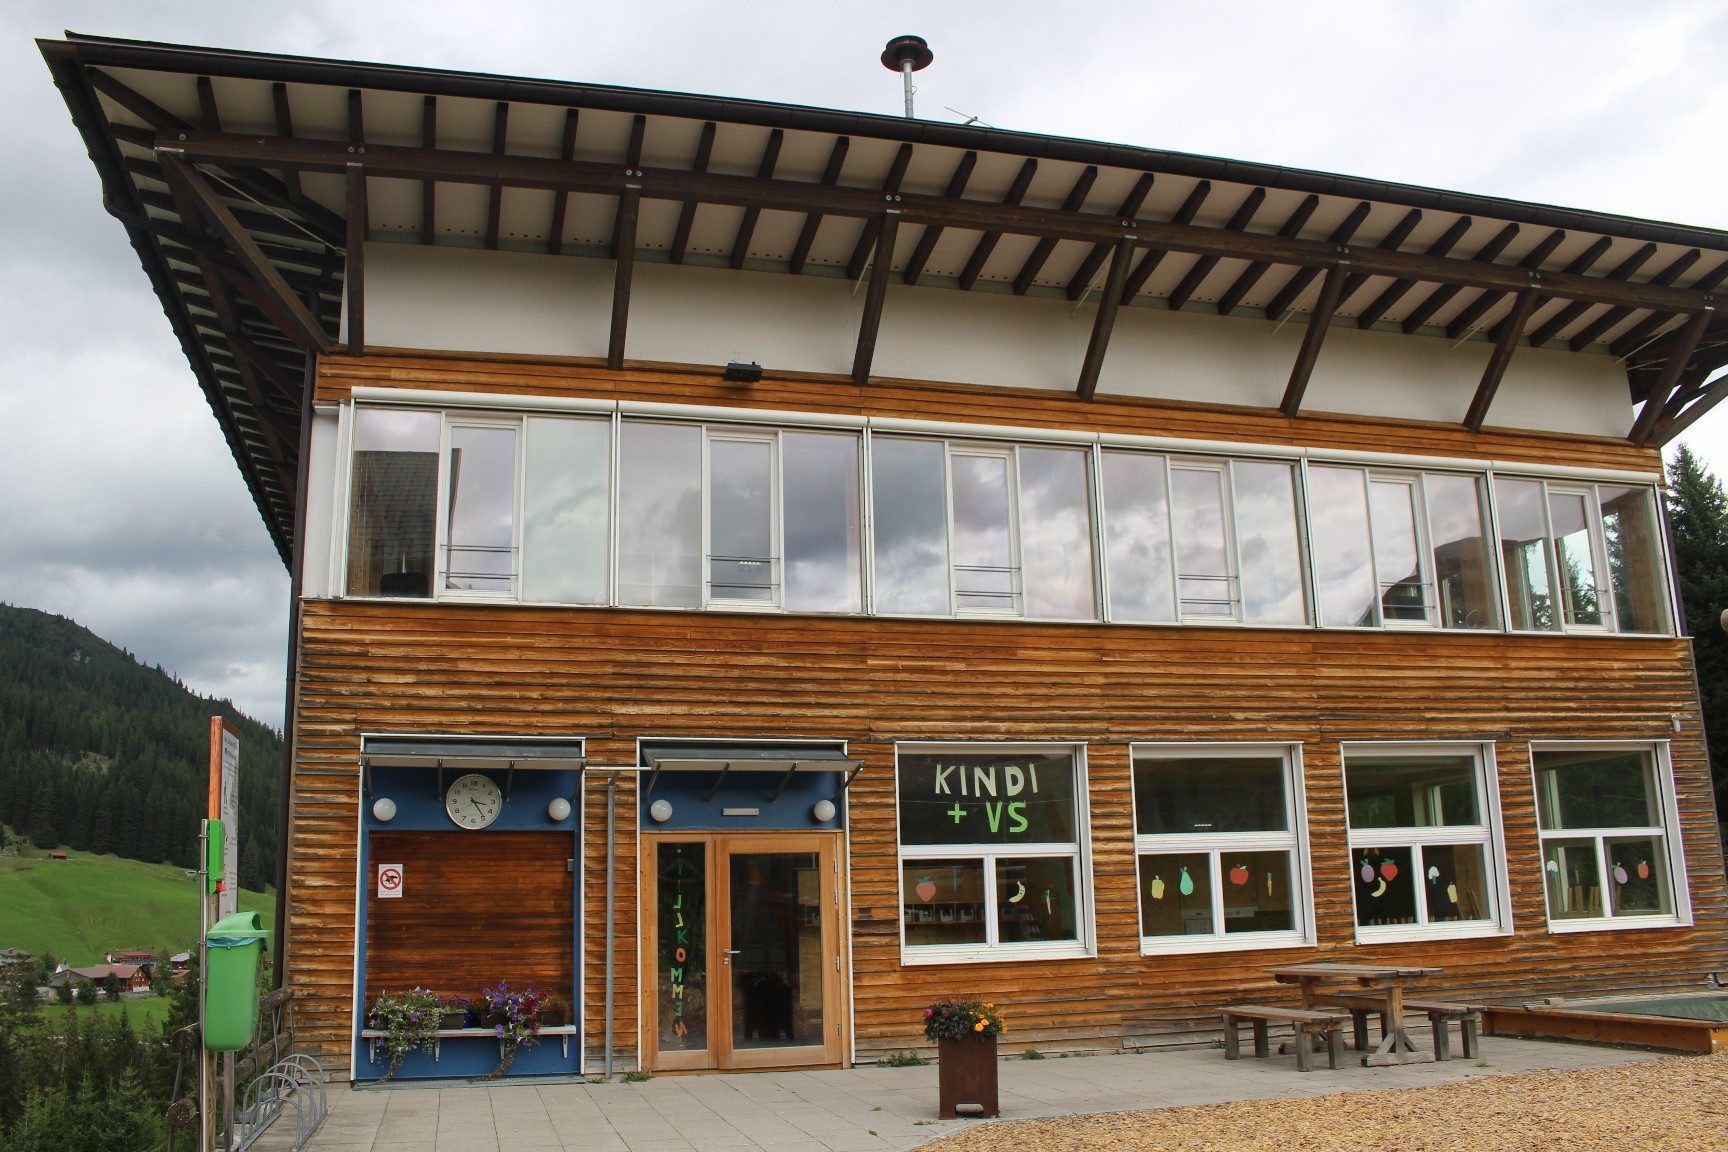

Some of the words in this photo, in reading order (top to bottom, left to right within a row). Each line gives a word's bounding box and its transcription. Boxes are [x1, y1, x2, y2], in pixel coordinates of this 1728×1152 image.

[935, 763, 1038, 797] KINDI
[947, 802, 967, 824] +
[986, 801, 1029, 833] VS
